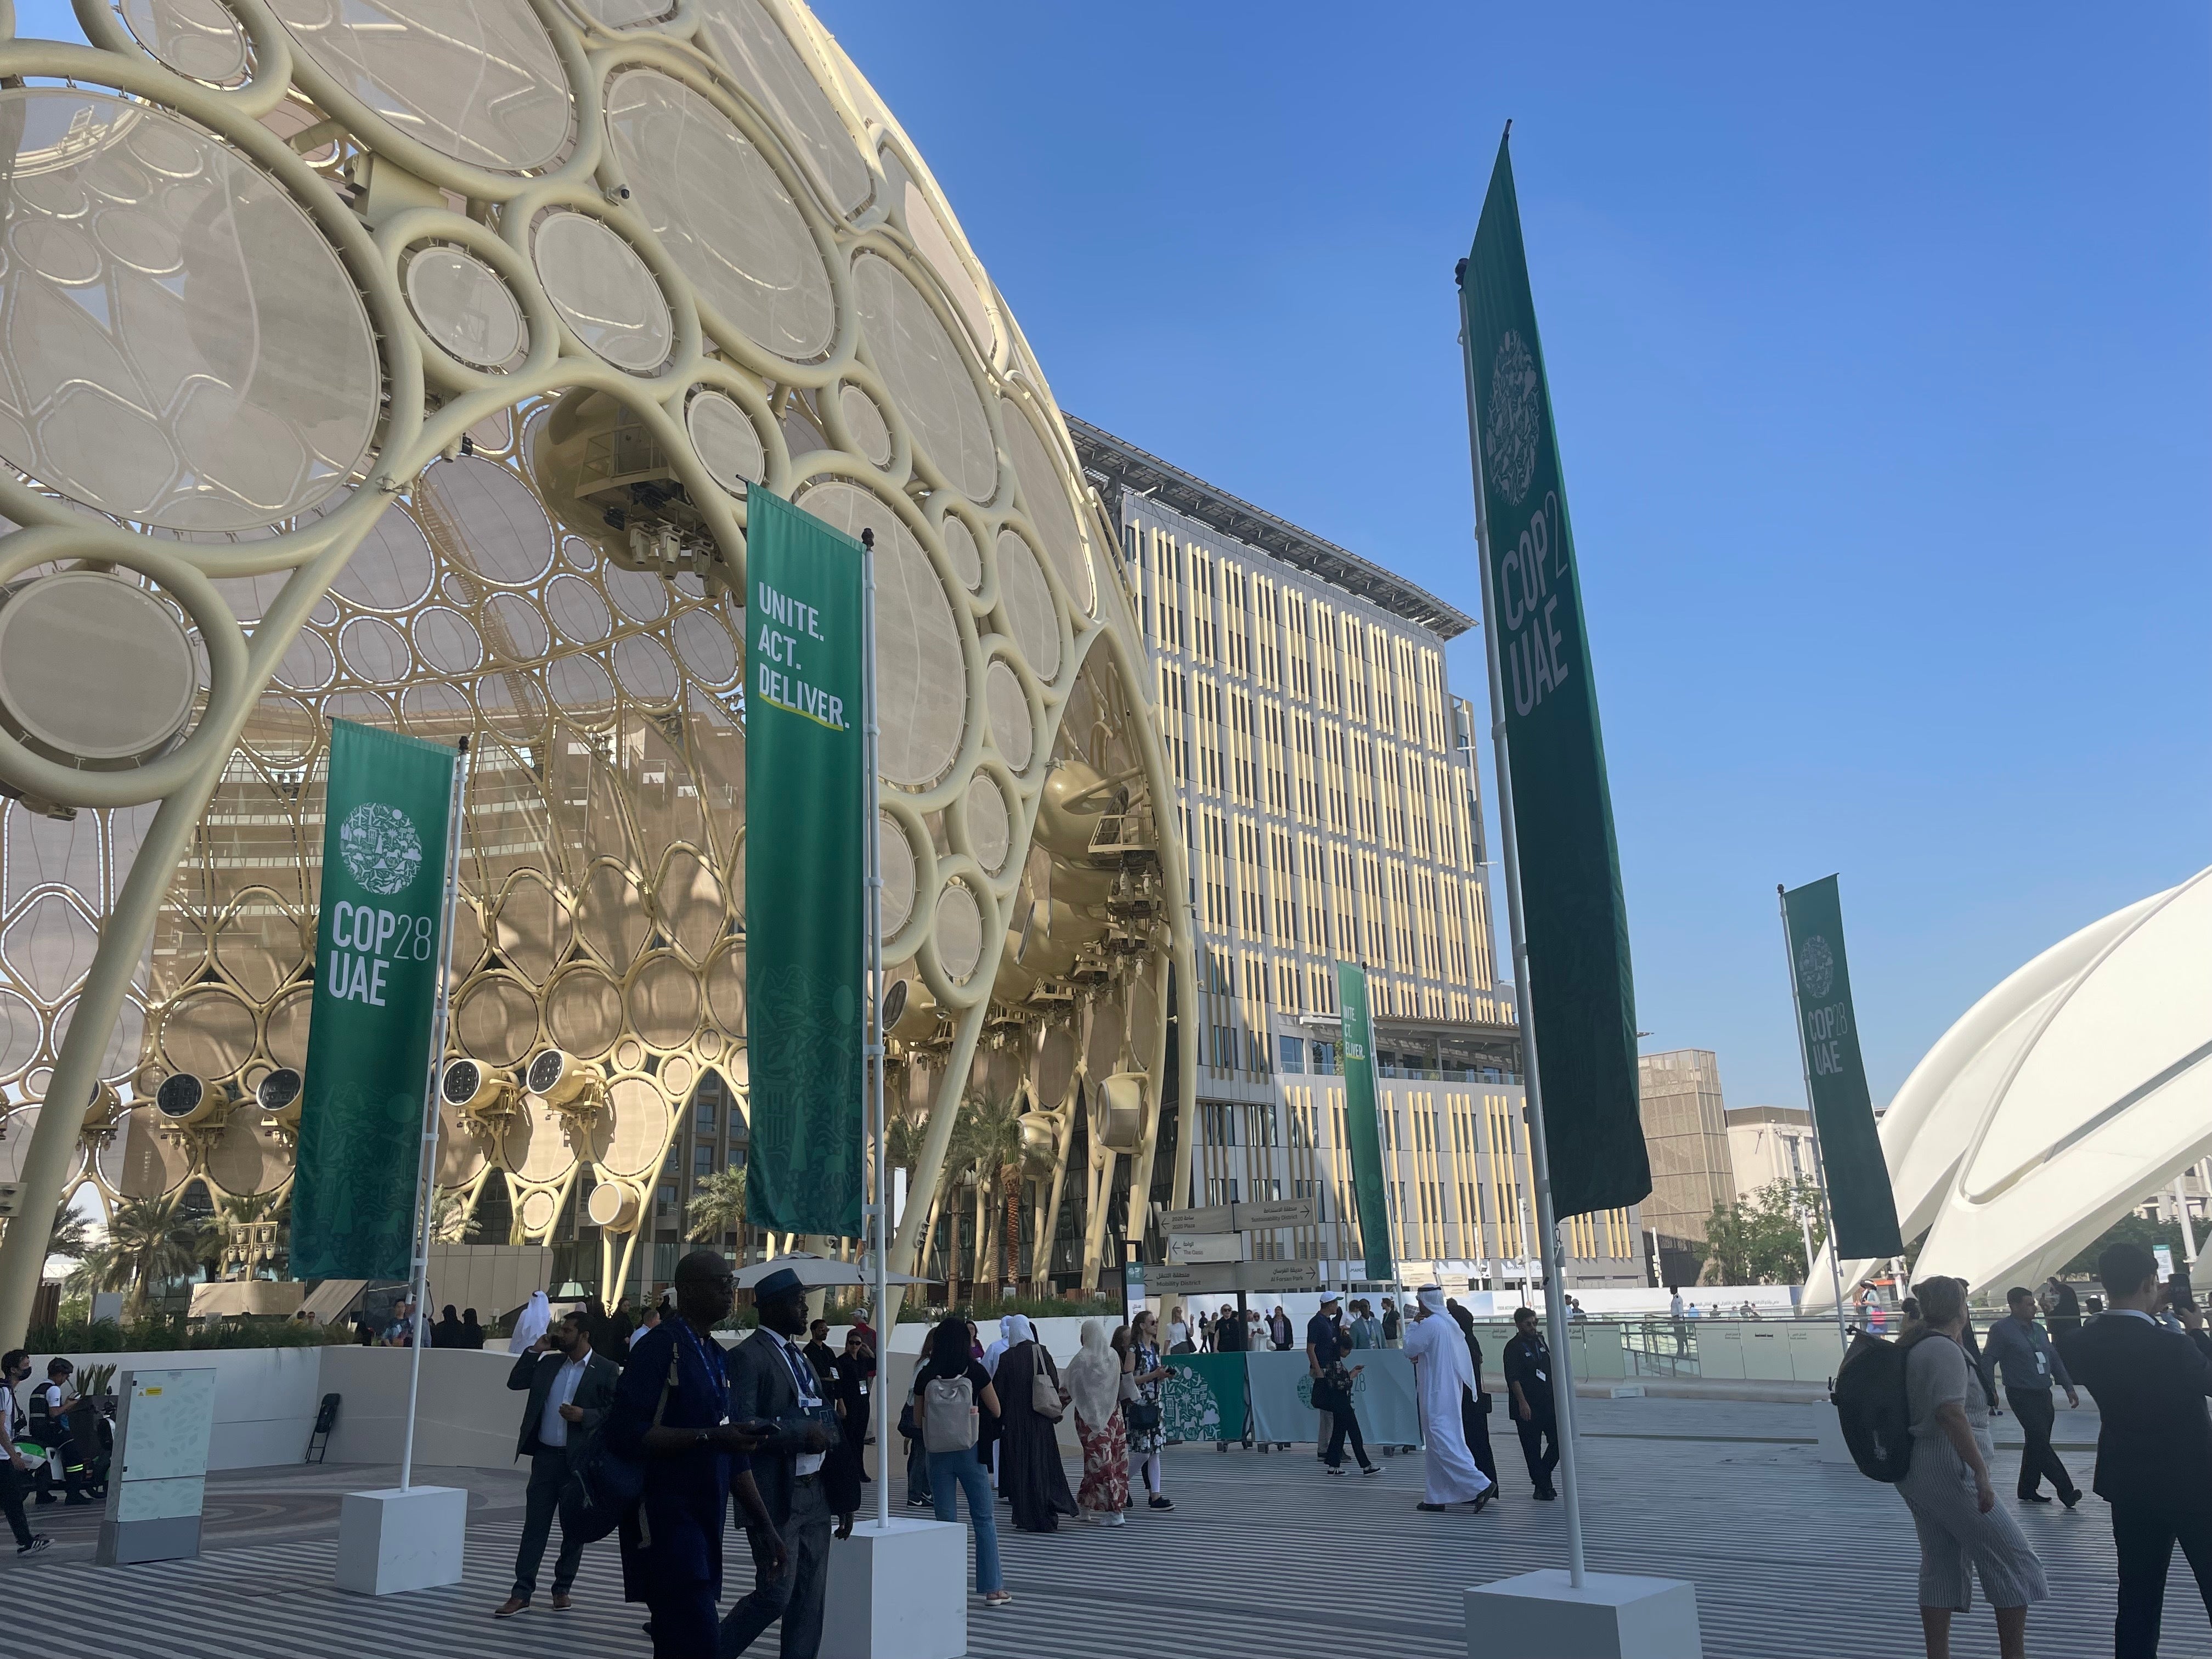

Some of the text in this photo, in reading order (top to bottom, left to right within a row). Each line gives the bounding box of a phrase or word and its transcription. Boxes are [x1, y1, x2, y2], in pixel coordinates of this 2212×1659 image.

[1500, 490, 1568, 631] COP2
[759, 581, 824, 641] UNITE.
[758, 623, 802, 670] ACT.
[1509, 592, 1569, 716] UAE
[759, 662, 850, 729] DELIVER.
[332, 900, 432, 961] COP28
[329, 950, 390, 1007] UAE
[1343, 1003, 1356, 1022] NITE.
[1344, 1023, 1352, 1038] CT.
[1808, 1002, 1847, 1042] COP28
[1345, 1041, 1365, 1059] ELIVER.
[1812, 1040, 1843, 1076] UAE
